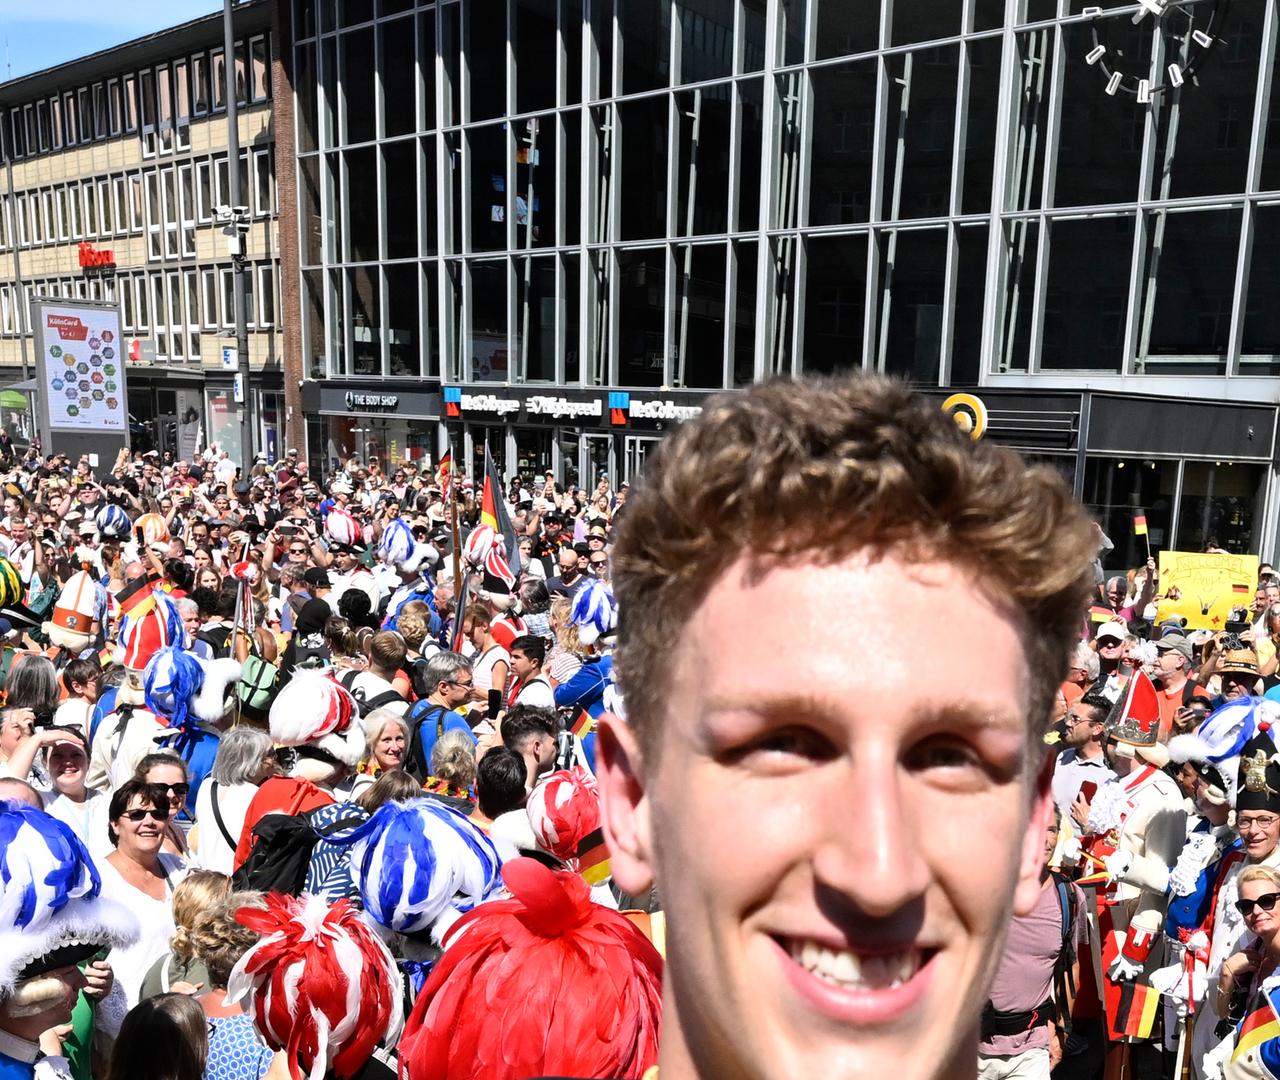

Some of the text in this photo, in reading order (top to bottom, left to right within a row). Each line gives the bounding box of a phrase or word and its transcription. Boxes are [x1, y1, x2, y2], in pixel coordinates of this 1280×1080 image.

[354, 394, 397, 407] THE BODY SHOP
